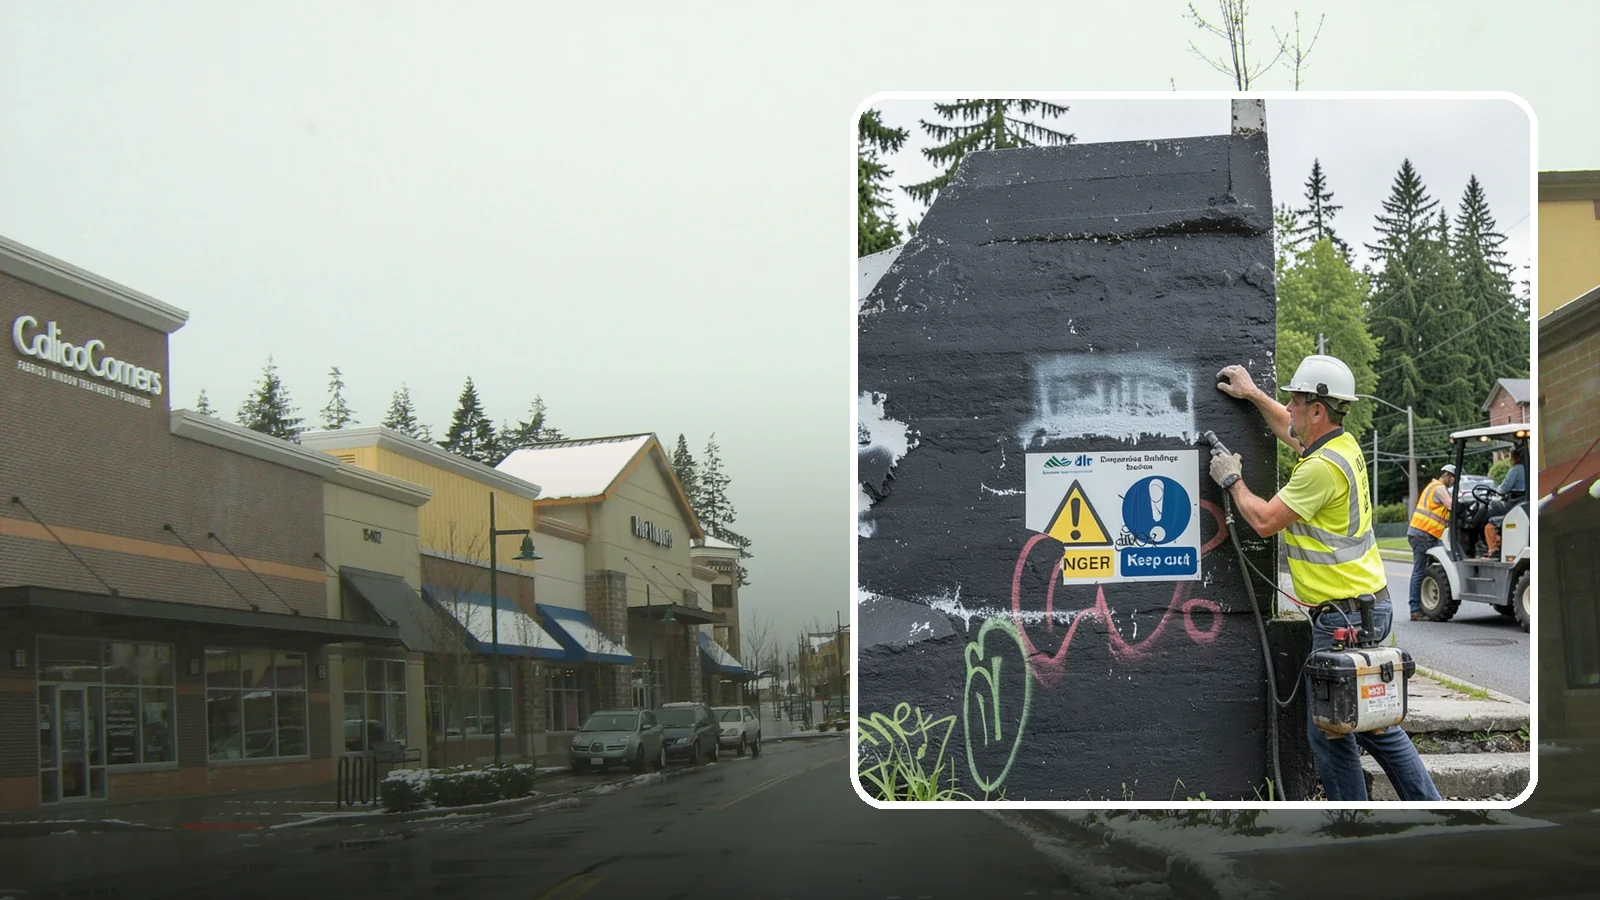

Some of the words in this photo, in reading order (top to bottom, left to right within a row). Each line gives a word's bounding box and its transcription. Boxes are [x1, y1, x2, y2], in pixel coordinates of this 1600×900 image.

[17, 360, 47, 377] FABRICS
[51, 370, 78, 386] WINDOW
[78, 379, 117, 398] TREATMENTS
[120, 391, 151, 409] FURNITURE
[1127, 554, 1161, 569] Keep
